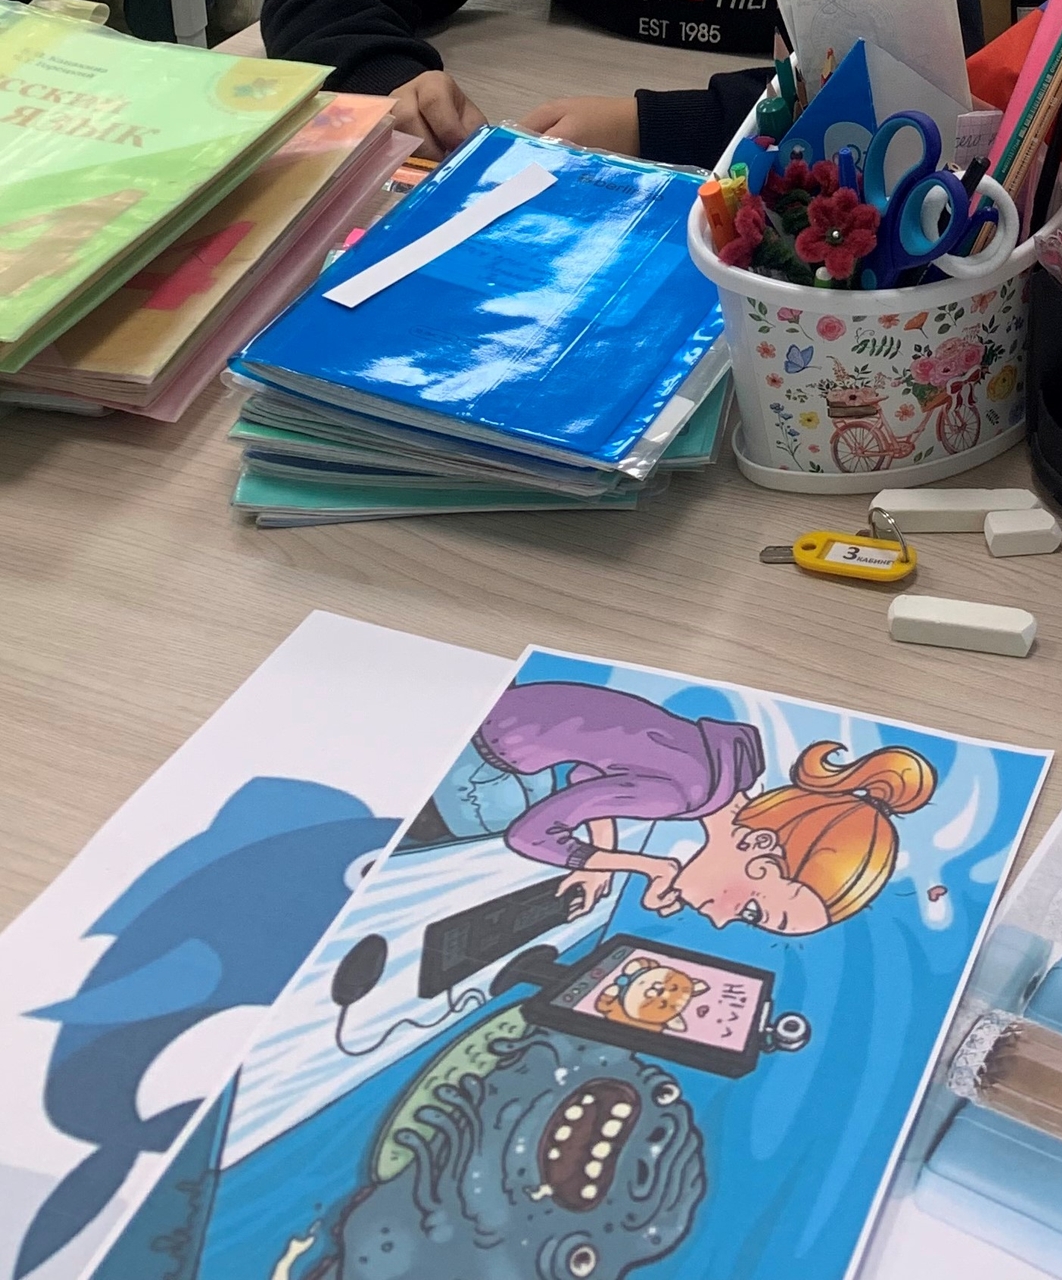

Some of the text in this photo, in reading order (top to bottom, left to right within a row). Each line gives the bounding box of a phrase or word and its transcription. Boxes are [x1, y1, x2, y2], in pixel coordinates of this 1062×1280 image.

[639, 18, 721, 44] EST 1985
[843, 546, 860, 560] 3
